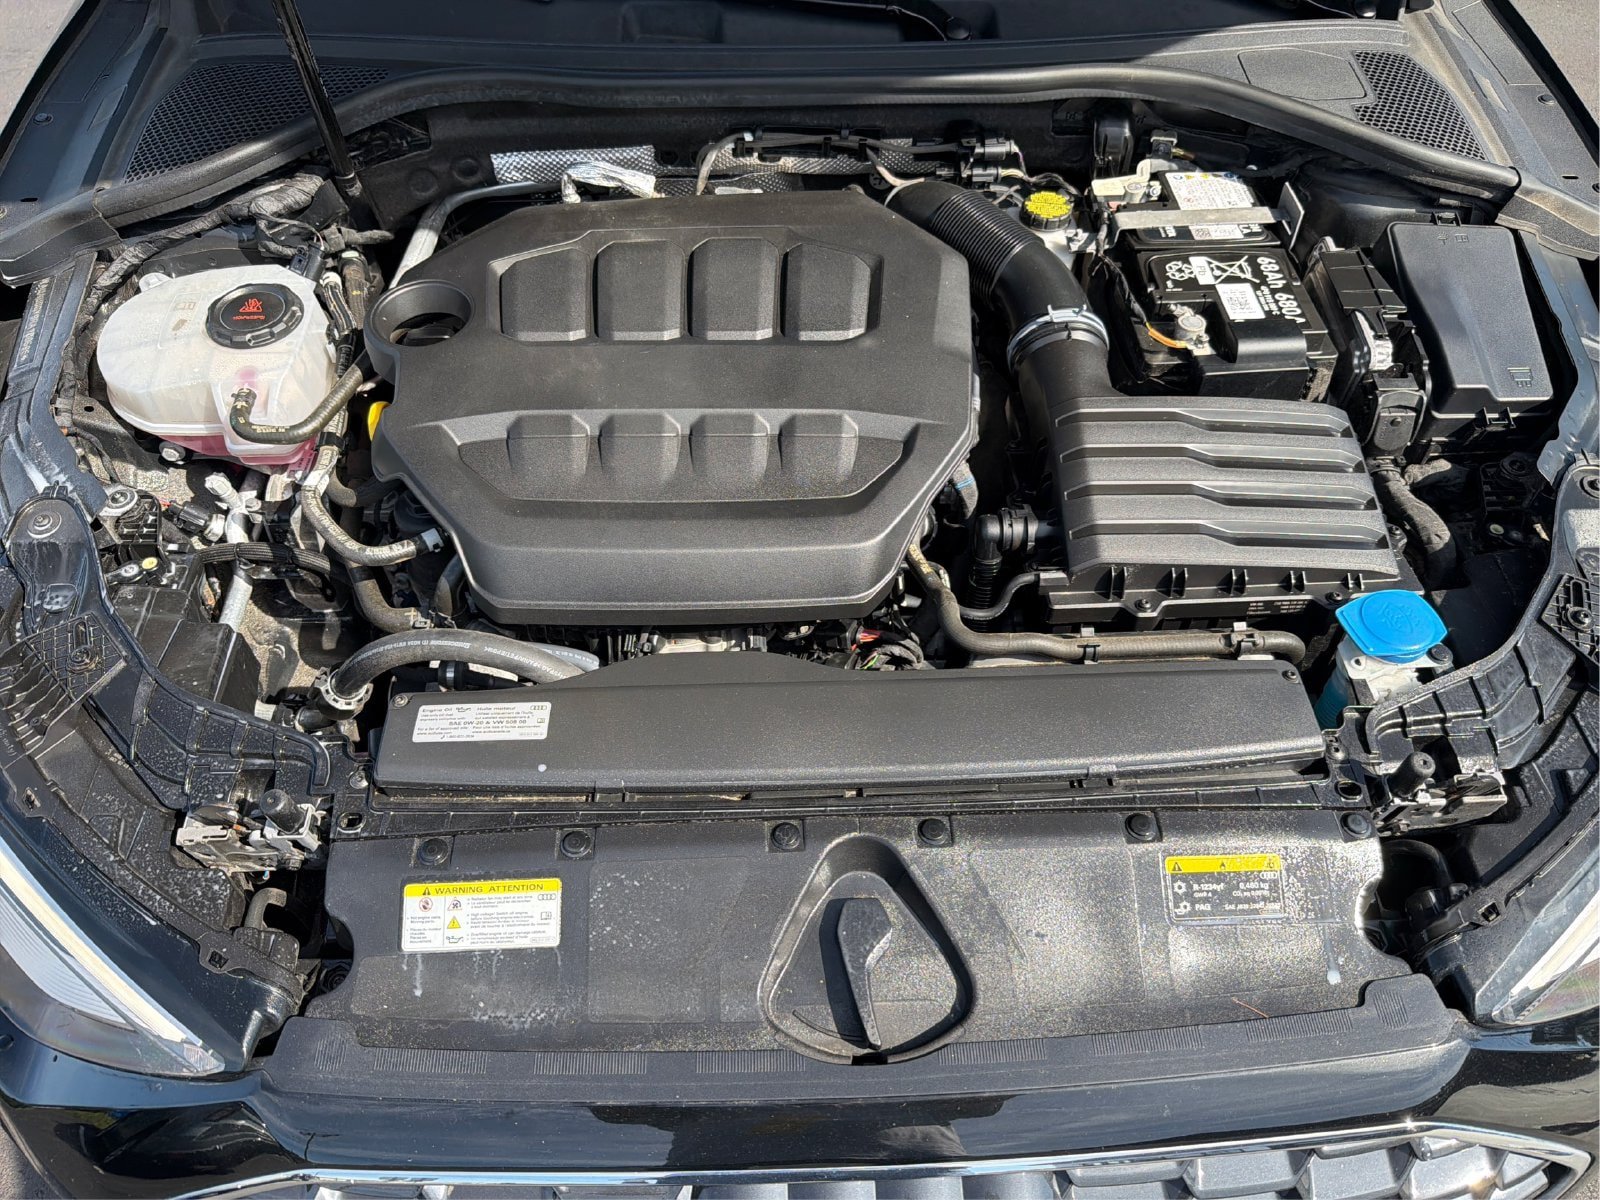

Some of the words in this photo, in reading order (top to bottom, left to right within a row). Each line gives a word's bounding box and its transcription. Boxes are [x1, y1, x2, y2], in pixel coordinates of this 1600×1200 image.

[1256, 256, 1287, 288] 68Ah
[435, 886, 483, 895] WARNING
[489, 884, 544, 892] ATTENTION
[1193, 882, 1224, 891] R-1234yf
